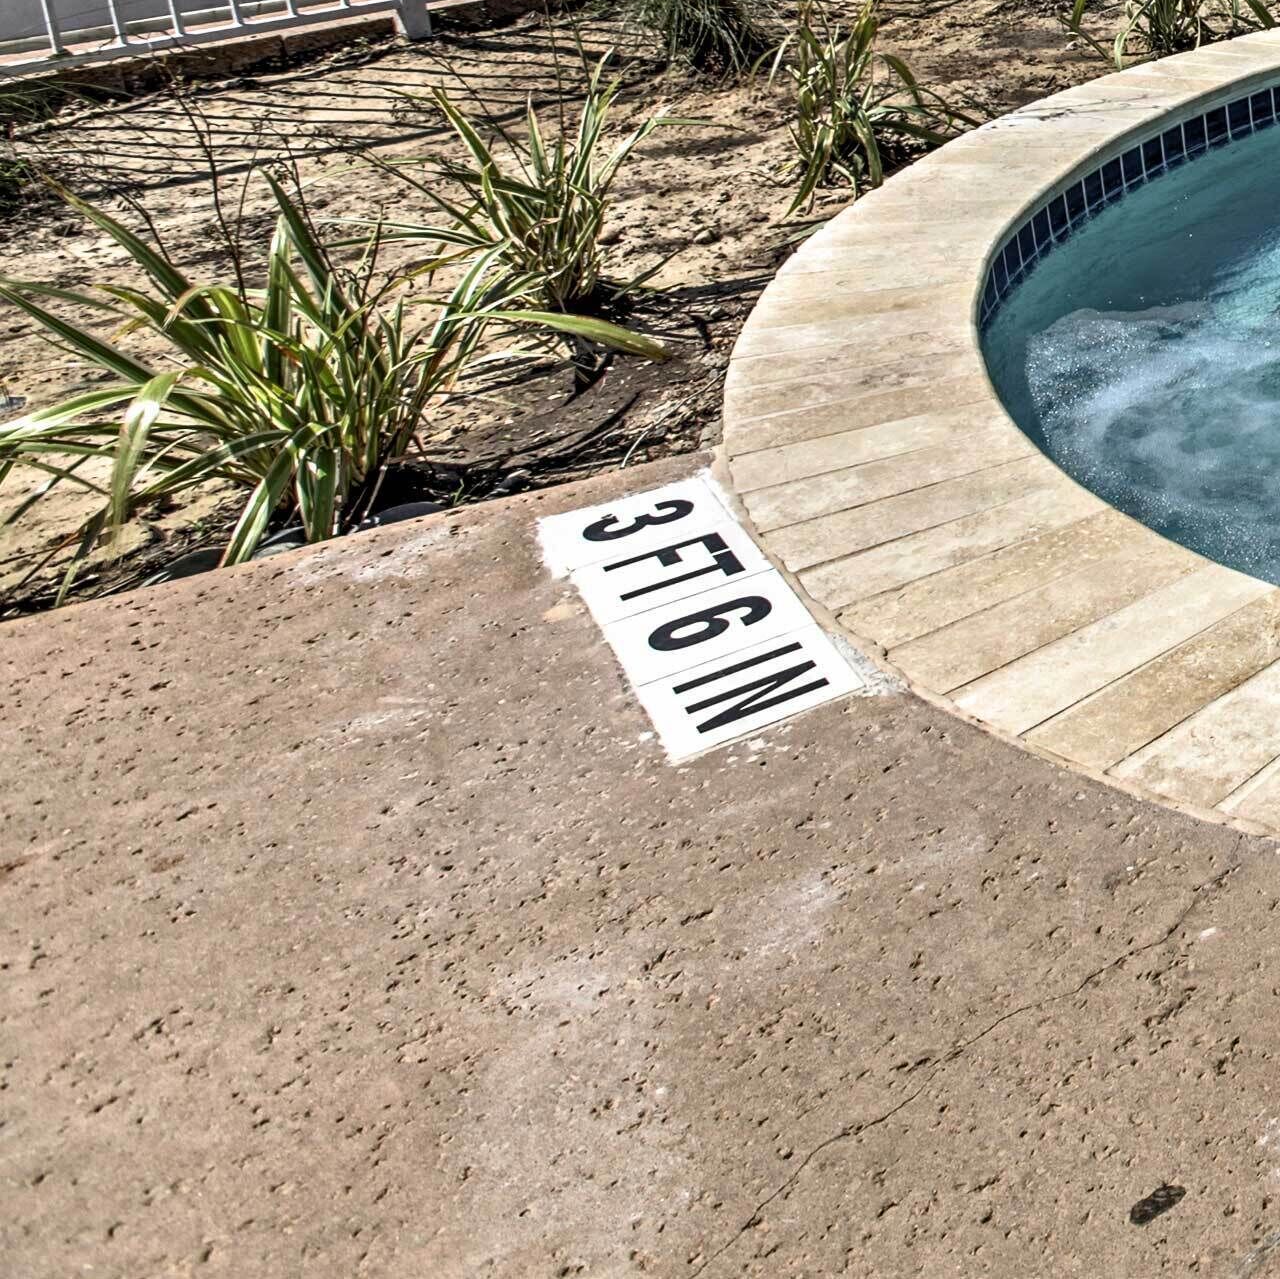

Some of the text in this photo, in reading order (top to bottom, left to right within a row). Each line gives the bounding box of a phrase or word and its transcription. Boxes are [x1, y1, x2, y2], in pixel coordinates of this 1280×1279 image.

[582, 499, 830, 734] 3 FT 6 IN
